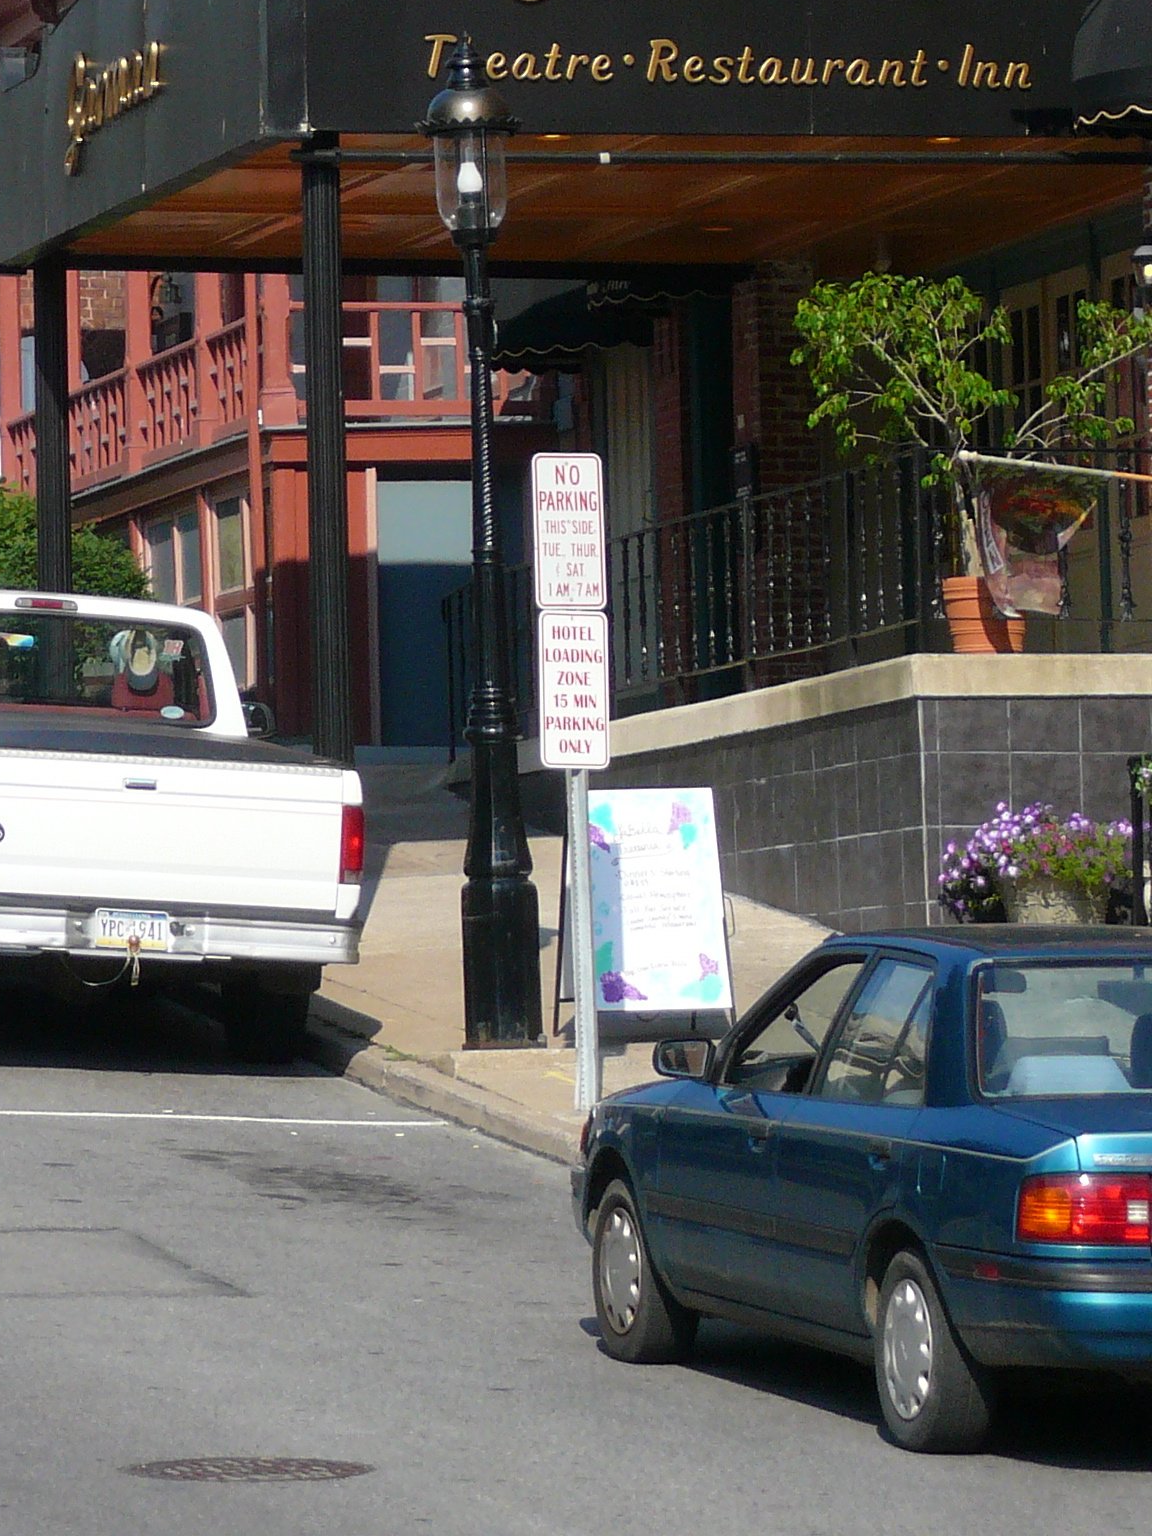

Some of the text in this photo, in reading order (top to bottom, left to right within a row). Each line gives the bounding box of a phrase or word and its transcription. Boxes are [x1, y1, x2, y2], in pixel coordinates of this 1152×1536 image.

[424, 33, 1034, 91] Teatre Restaurant Inn
[555, 464, 580, 485] NO
[538, 490, 598, 512] PARKING
[544, 519, 594, 535] THIS SIDE
[551, 625, 596, 641] HOTEL
[544, 647, 603, 664] LOADING
[557, 670, 591, 686] ZONE
[553, 693, 597, 709] 15 MIN
[545, 716, 605, 732] PARKING
[559, 739, 592, 754] ONLY
